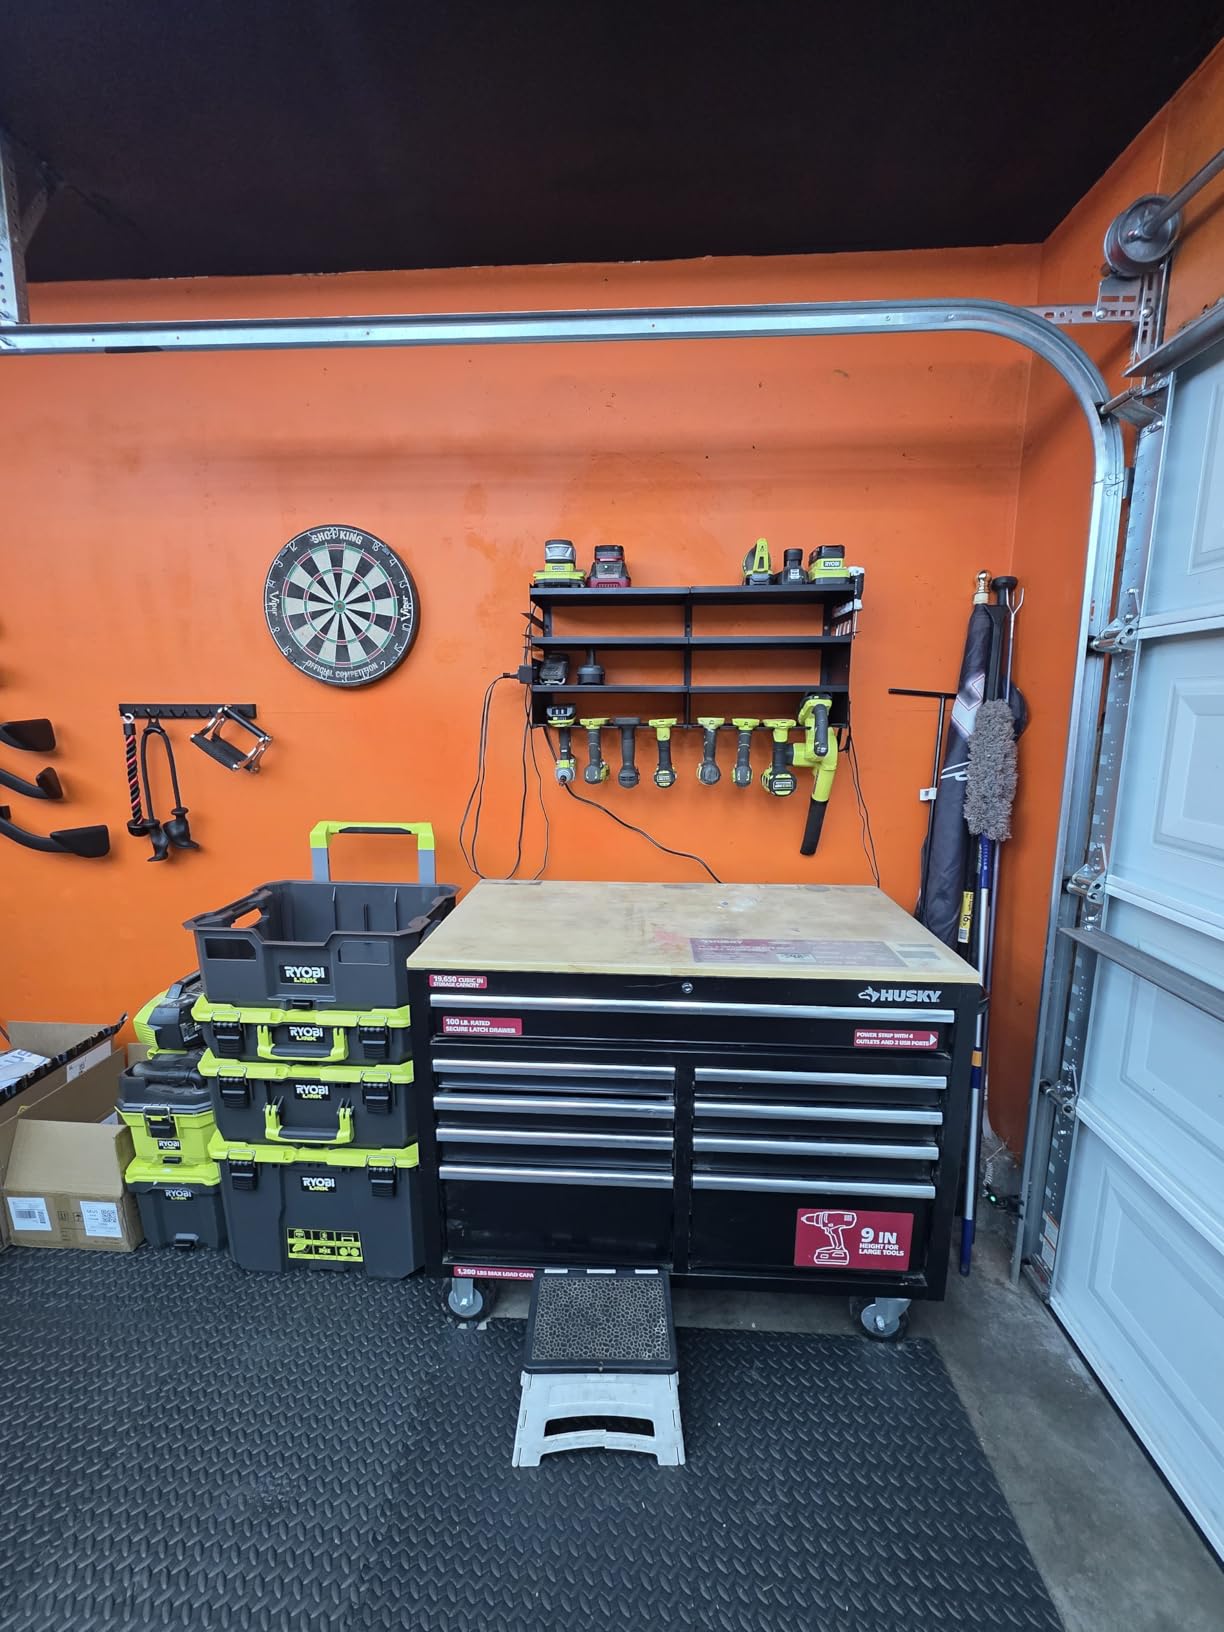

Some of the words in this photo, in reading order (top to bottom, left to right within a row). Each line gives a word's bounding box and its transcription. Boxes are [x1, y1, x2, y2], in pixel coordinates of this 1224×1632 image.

[312, 530, 337, 544] SHOT
[339, 530, 363, 544] KING
[269, 591, 279, 617] Viper
[400, 595, 410, 621] Viper
[306, 661, 333, 676] OFFICIAL
[335, 663, 378, 677] COMPETITION
[284, 966, 325, 978] RYOBI
[880, 989, 942, 1002] HUSKY
[289, 1026, 324, 1037] RYOBI
[296, 1085, 329, 1095] RYOBI
[302, 1177, 335, 1187] RYOBI
[165, 1189, 191, 1197] RYOBI
[861, 1228, 874, 1243] 9
[878, 1231, 897, 1244] IN
